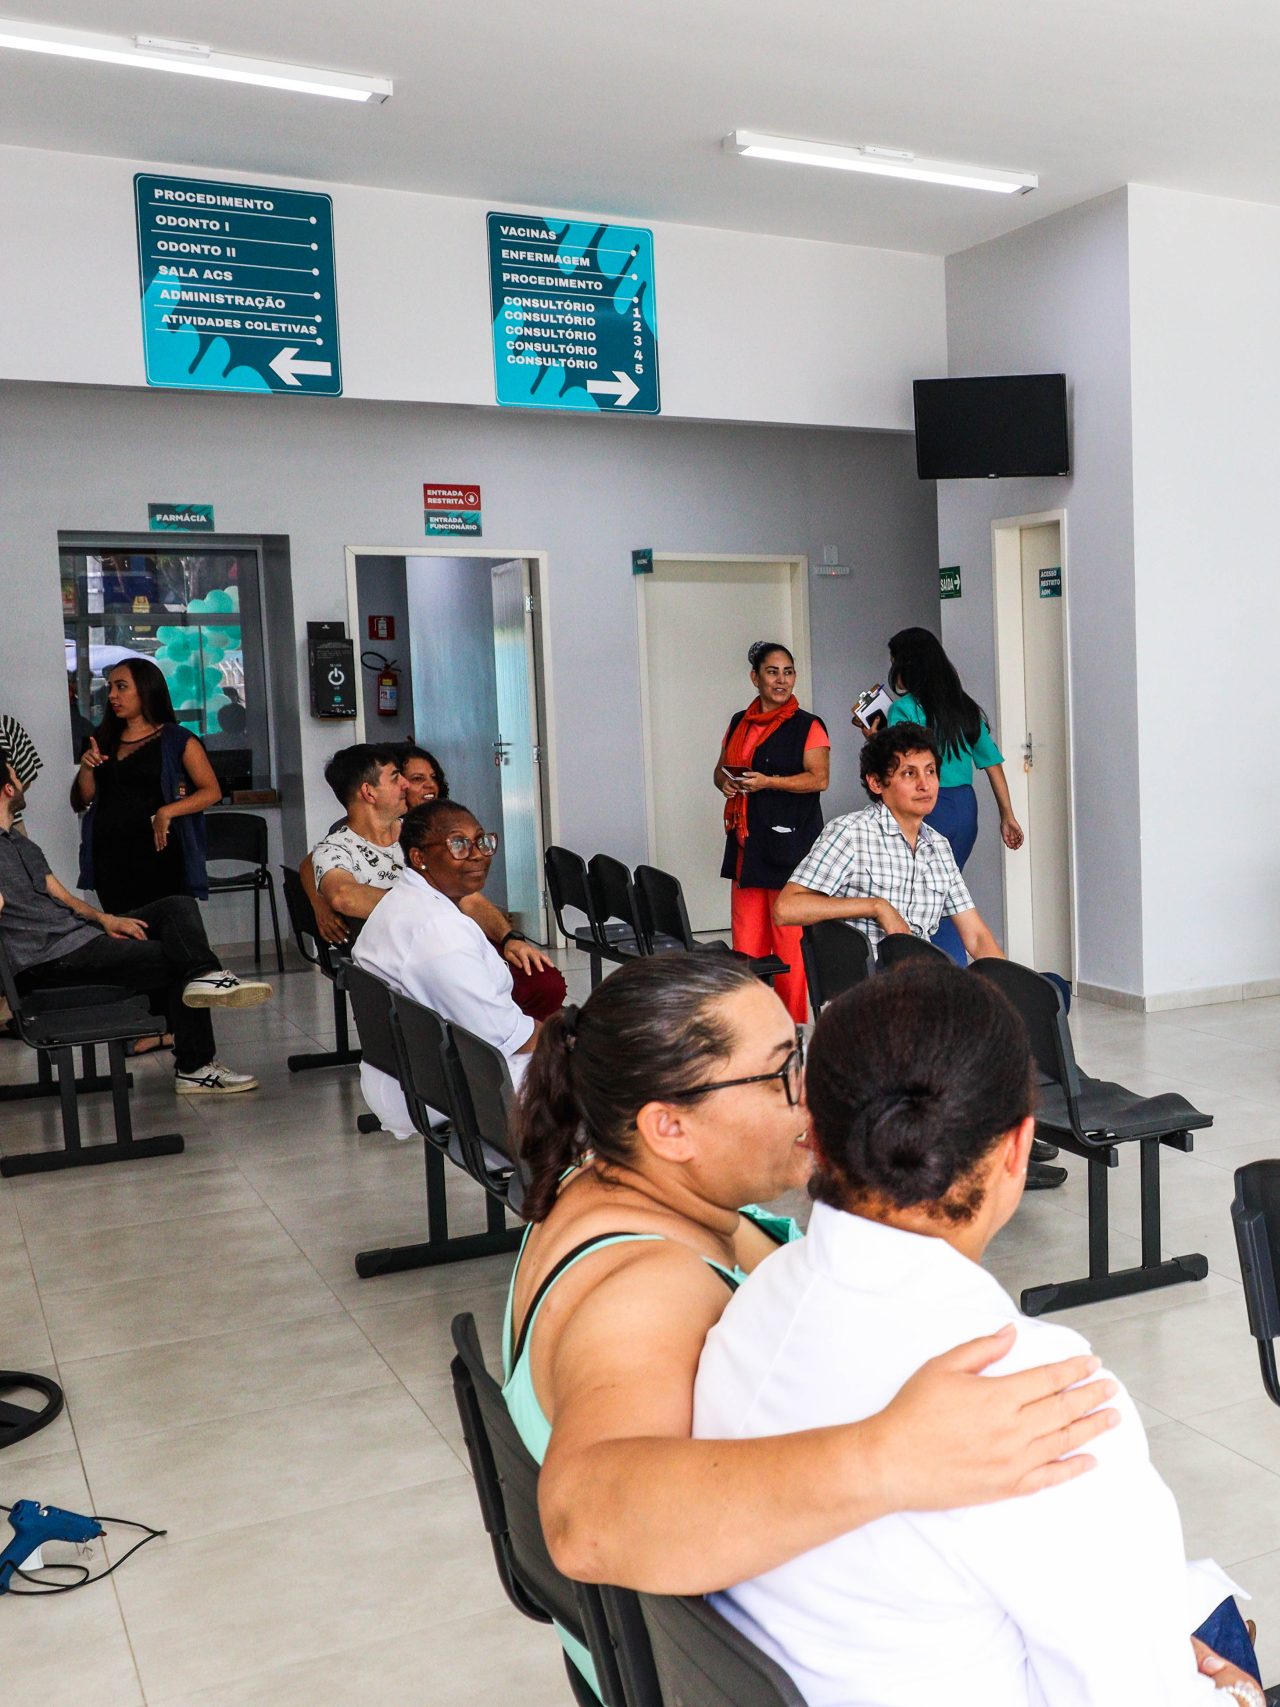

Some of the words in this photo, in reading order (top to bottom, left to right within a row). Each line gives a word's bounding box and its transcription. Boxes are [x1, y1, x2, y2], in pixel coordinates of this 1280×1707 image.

[154, 188, 274, 211] PROCEDIMENTO
[155, 214, 220, 231] ODONTO
[224, 221, 230, 232] I
[500, 225, 557, 240] VACINAS
[157, 240, 222, 256] ODONTO
[226, 246, 236, 258] II
[502, 250, 590, 267] ENFERMAGEM
[158, 265, 198, 279] SALA
[202, 269, 233, 281] ACS
[502, 272, 603, 290] PROCEDIMENTO
[160, 289, 286, 310] ADMINISTRAÇÃO
[504, 296, 595, 312] CONSULTÓRIO
[632, 308, 641, 318] 1
[161, 314, 242, 329] ATIVIDADES
[244, 321, 318, 334] COLETIVAS
[504, 310, 596, 326] CONSULTÓRIO
[632, 321, 642, 332] 2
[506, 326, 596, 341] CONSULTÓRIO
[634, 335, 642, 346] 3
[506, 340, 598, 356] CONSULTÓRIO
[634, 350, 643, 360] 4
[507, 355, 598, 370] CONSULTÓRIO
[634, 364, 644, 374] 5
[156, 513, 207, 522] FARMÁCIA
[940, 576, 954, 592] SAÍDA
